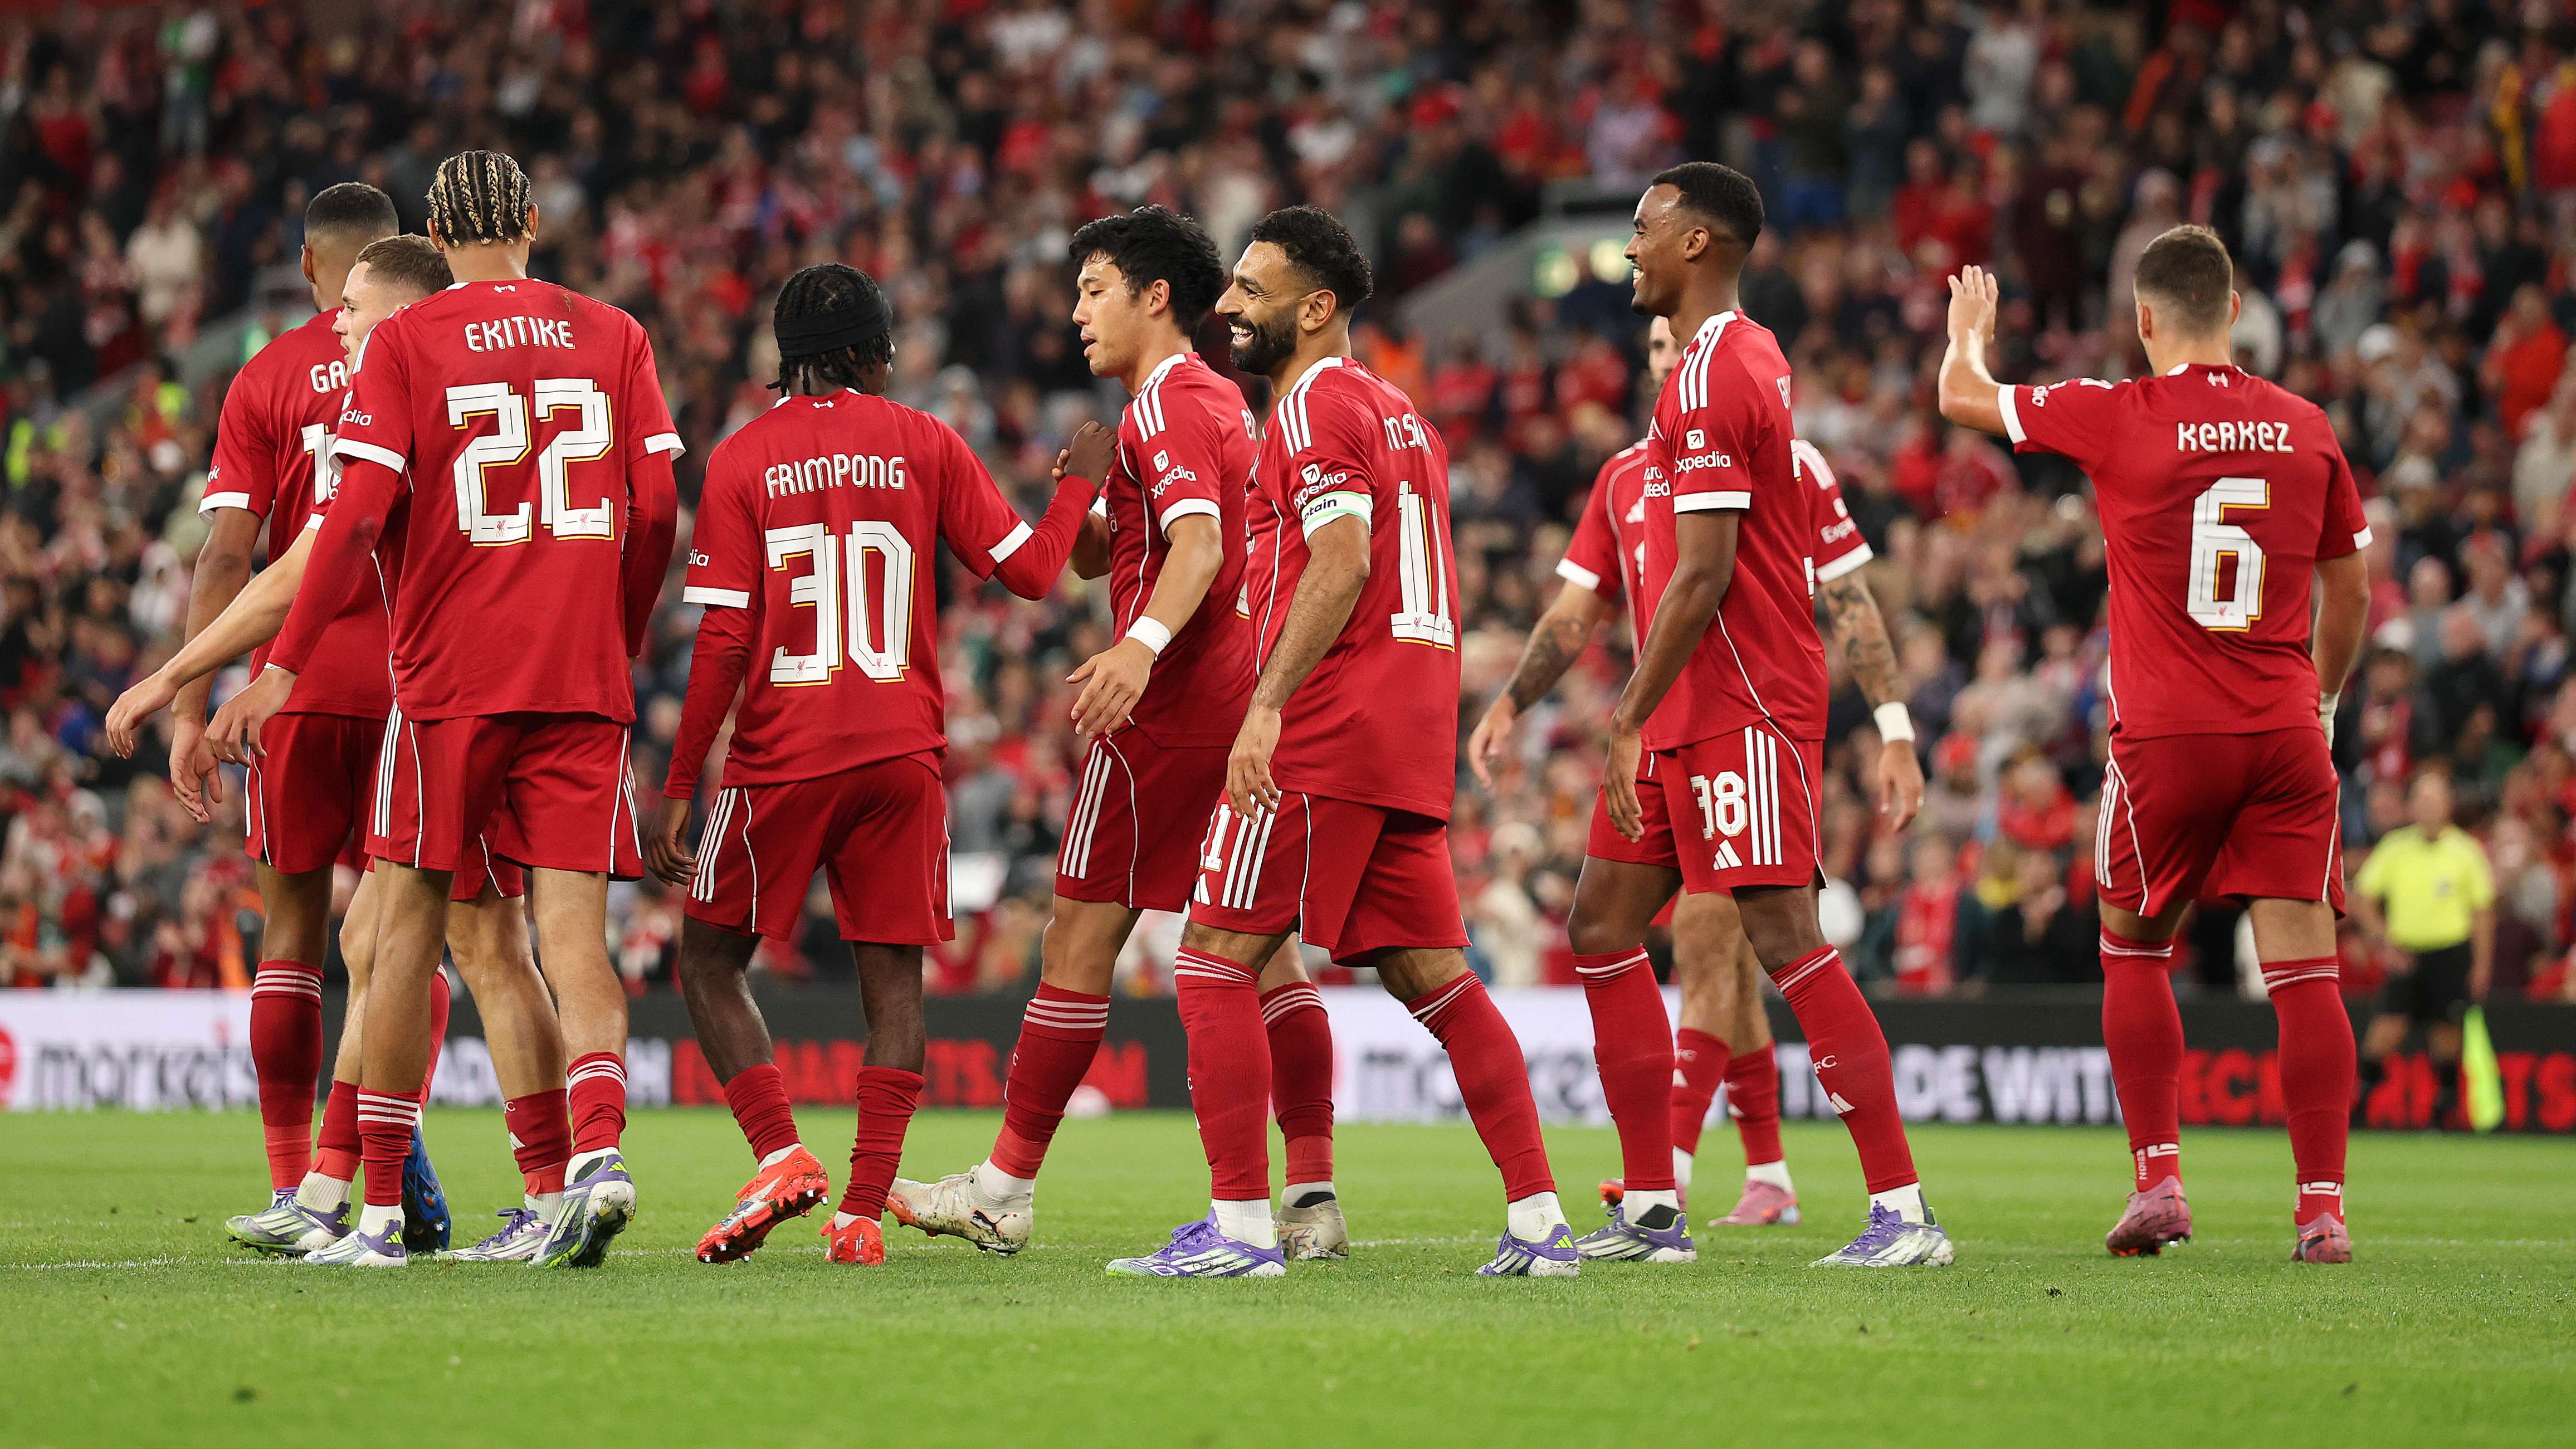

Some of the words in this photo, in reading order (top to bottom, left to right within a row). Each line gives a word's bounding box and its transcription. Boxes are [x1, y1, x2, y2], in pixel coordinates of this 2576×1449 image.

[464, 315, 576, 352] EKITIKE
[446, 378, 614, 547] 22
[764, 453, 905, 499] FRIMPONG
[1675, 451, 1731, 474] xpedia
[2187, 477, 2271, 633] 6
[764, 521, 916, 688] 30
[1813, 1054, 1838, 1075] FC
